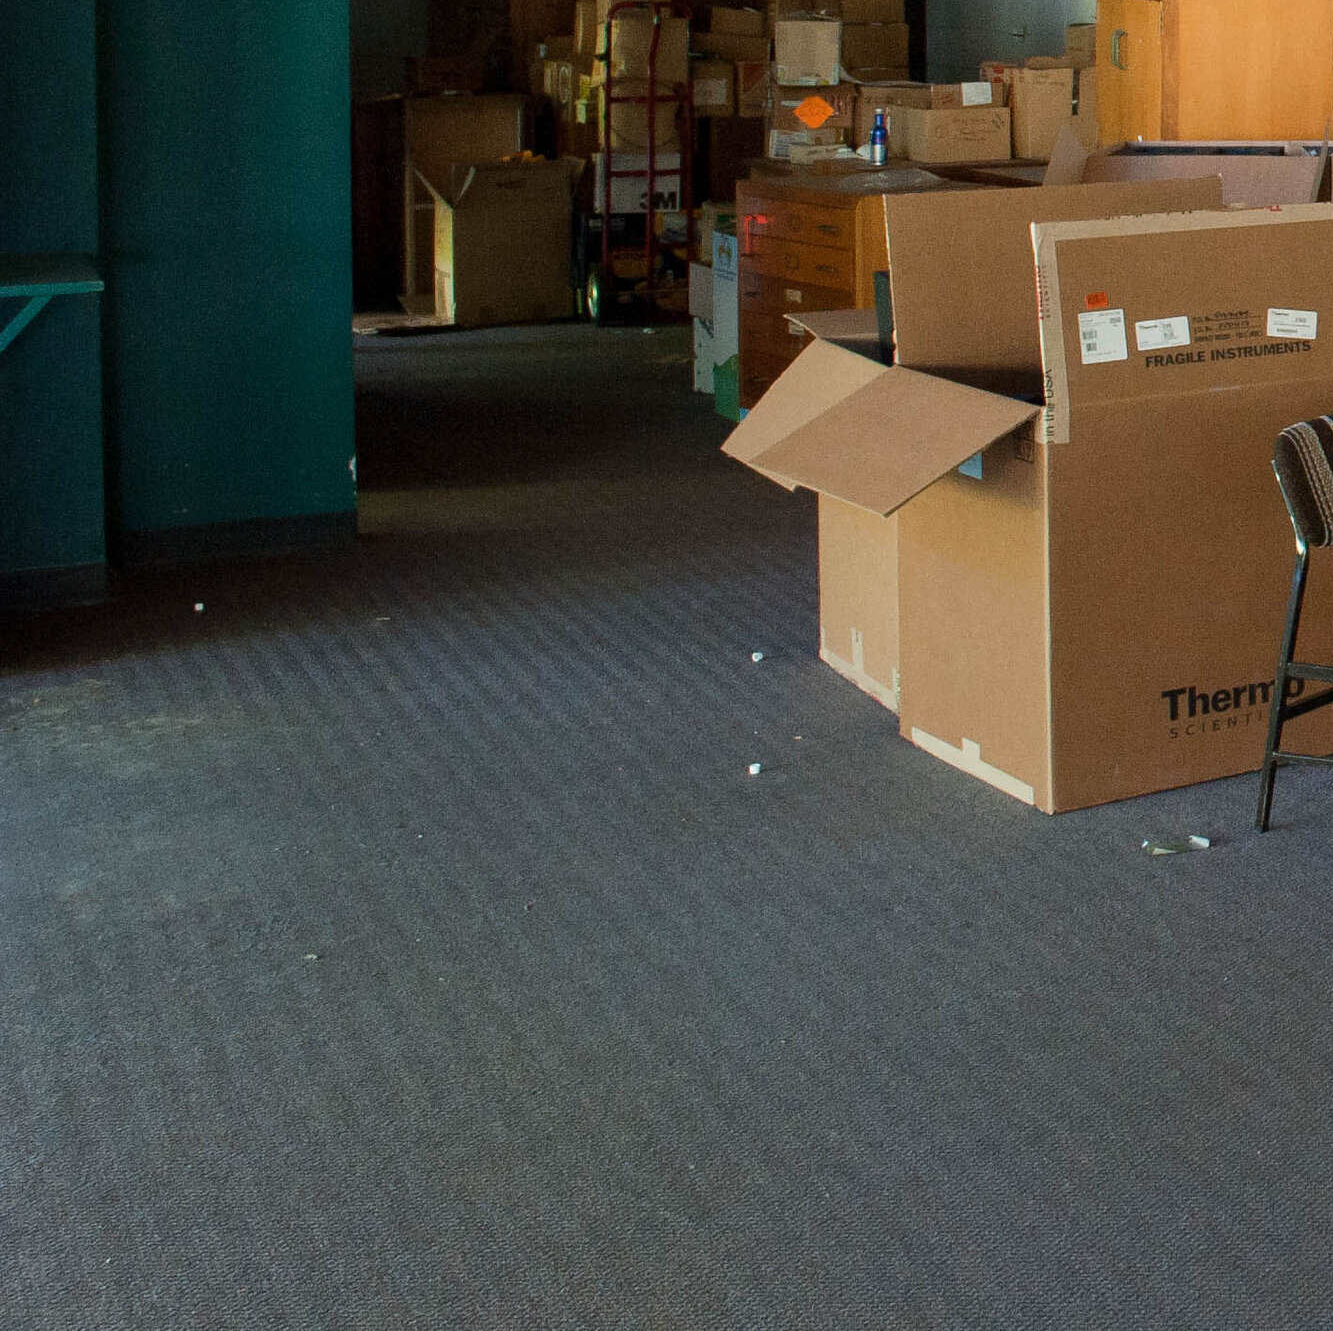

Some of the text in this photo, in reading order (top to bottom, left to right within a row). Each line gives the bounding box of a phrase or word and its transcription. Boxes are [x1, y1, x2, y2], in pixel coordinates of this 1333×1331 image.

[1145, 340, 1312, 368] FRAGILE INSTRUMENTS
[1161, 677, 1306, 721] Thermo
[1168, 713, 1264, 739] SCIENTI
